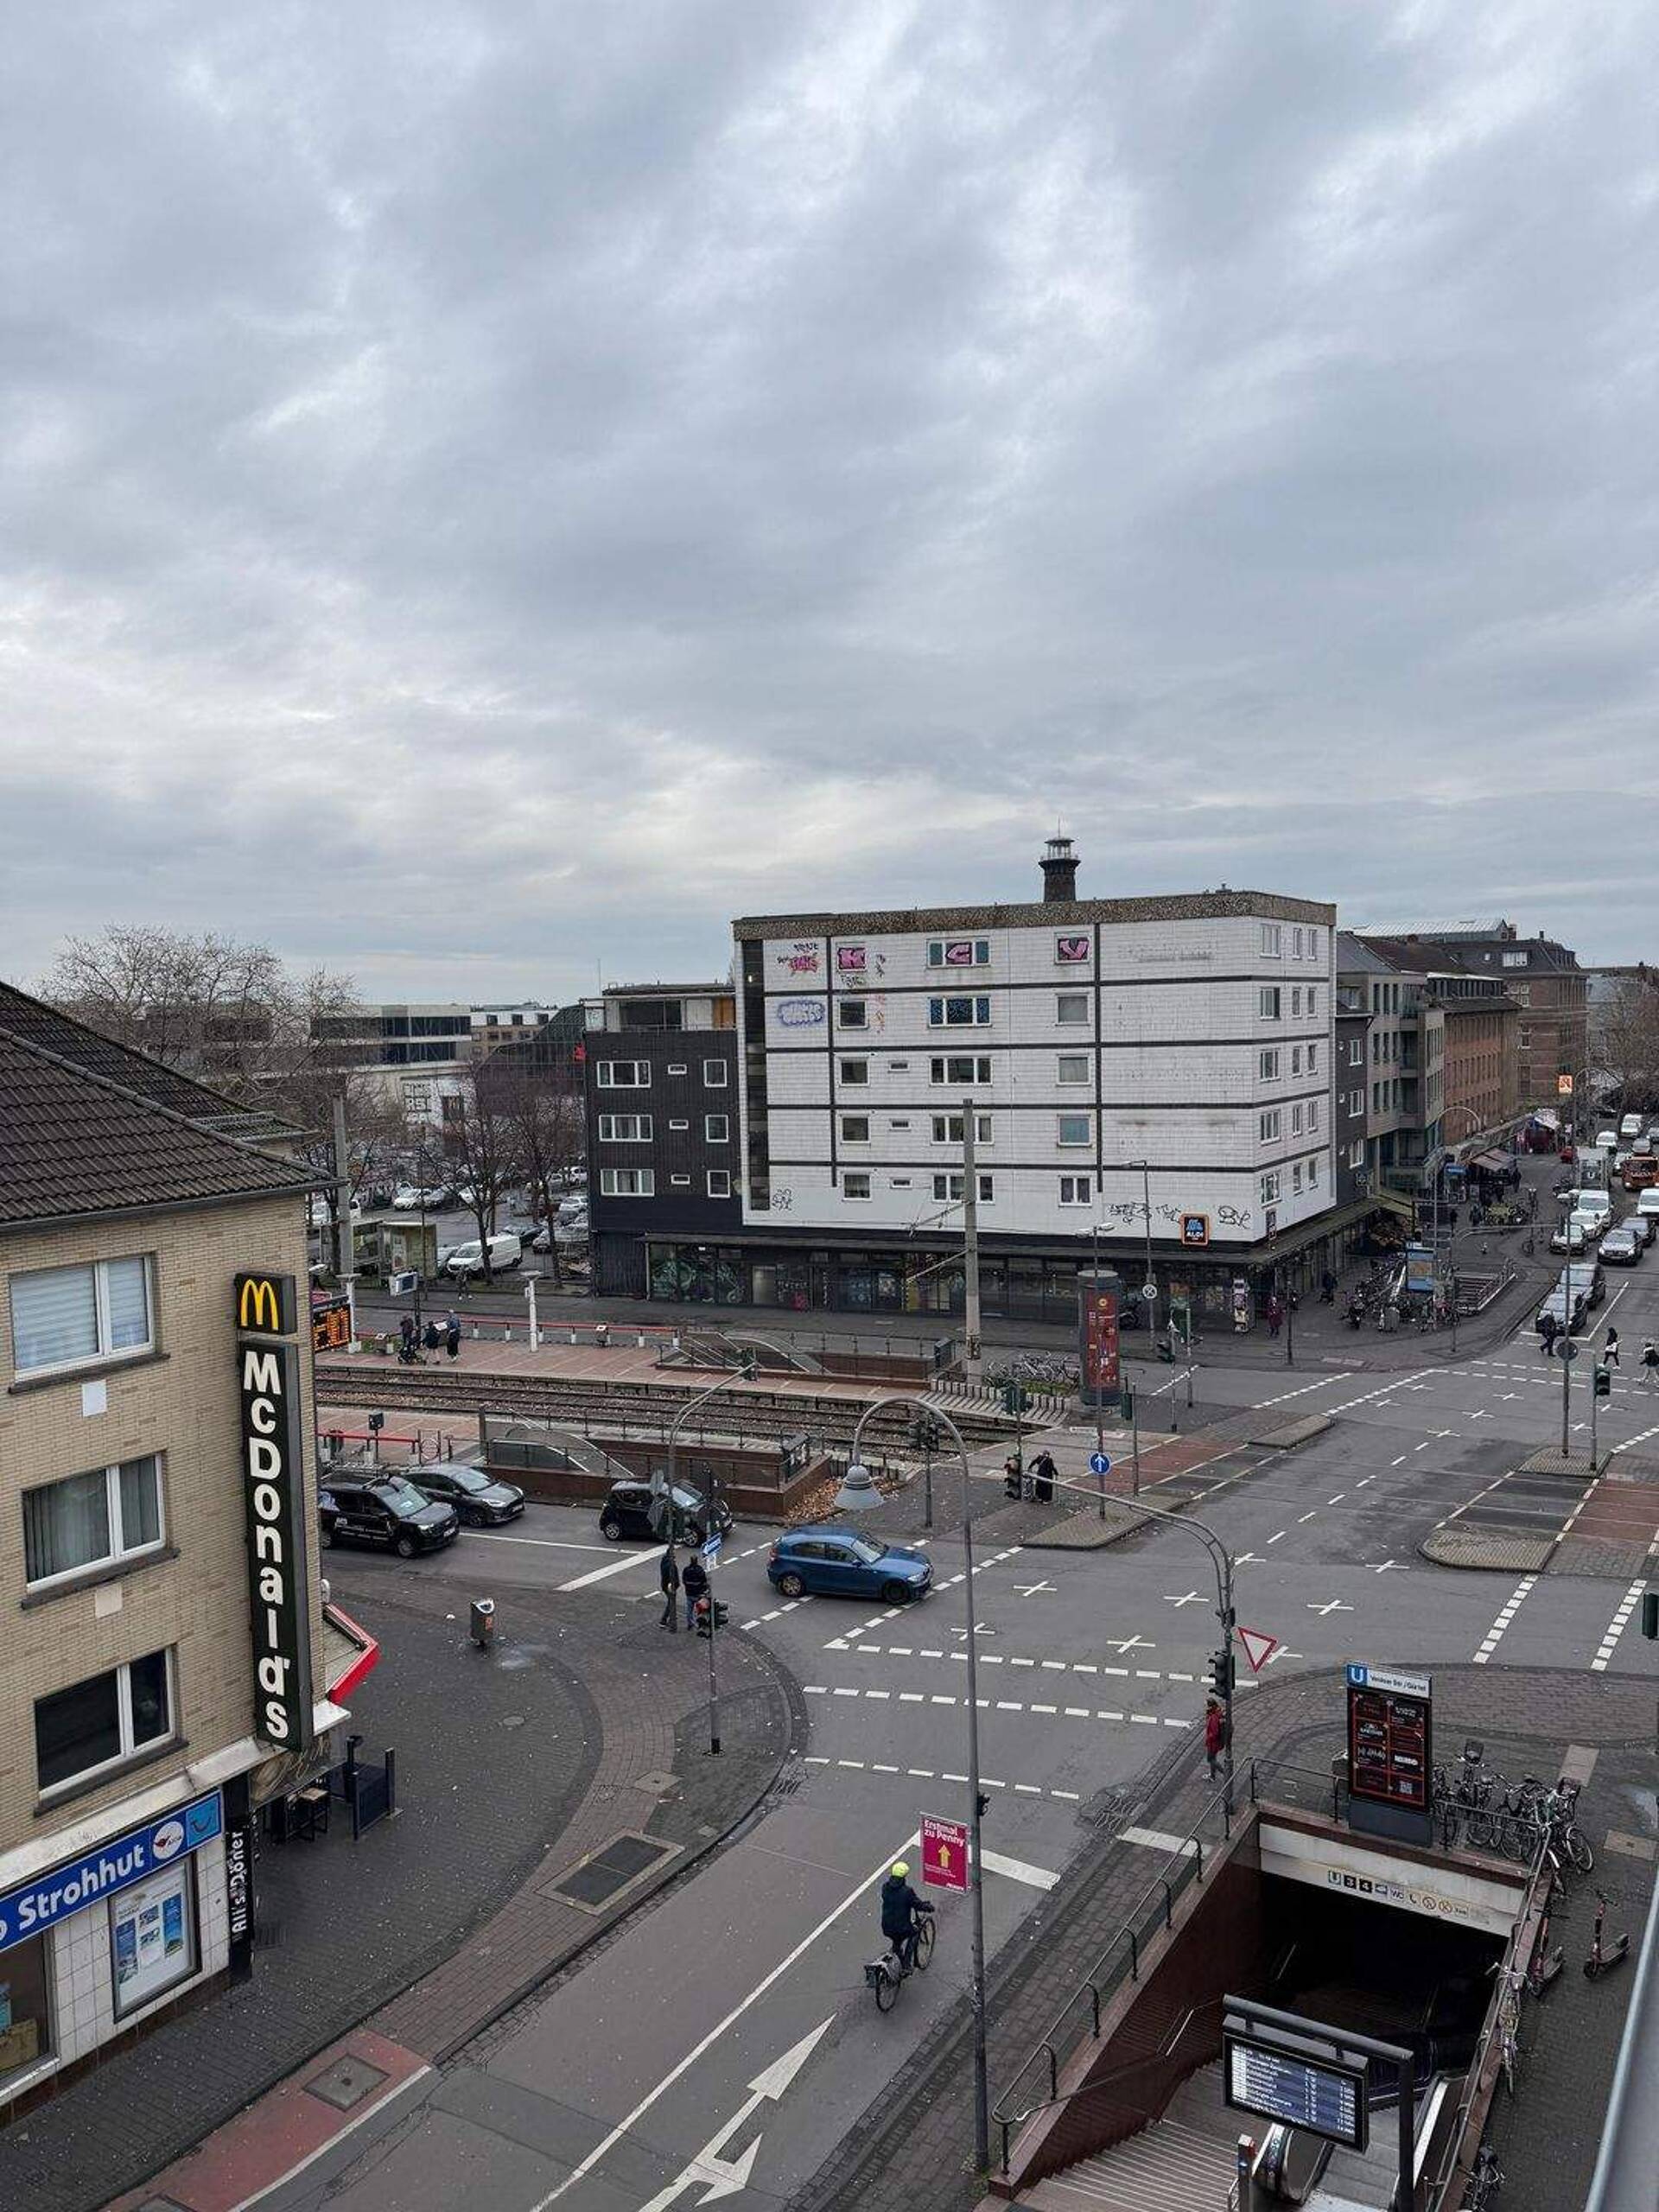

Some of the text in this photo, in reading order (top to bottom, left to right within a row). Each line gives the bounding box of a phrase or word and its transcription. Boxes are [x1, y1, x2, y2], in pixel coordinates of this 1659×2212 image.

[244, 1351, 289, 1738] McDonald's
[1351, 1668, 1363, 1682] U
[229, 1831, 246, 1887] Döner
[937, 1830, 964, 1847] Penny
[17, 1844, 145, 1931] Strohhut
